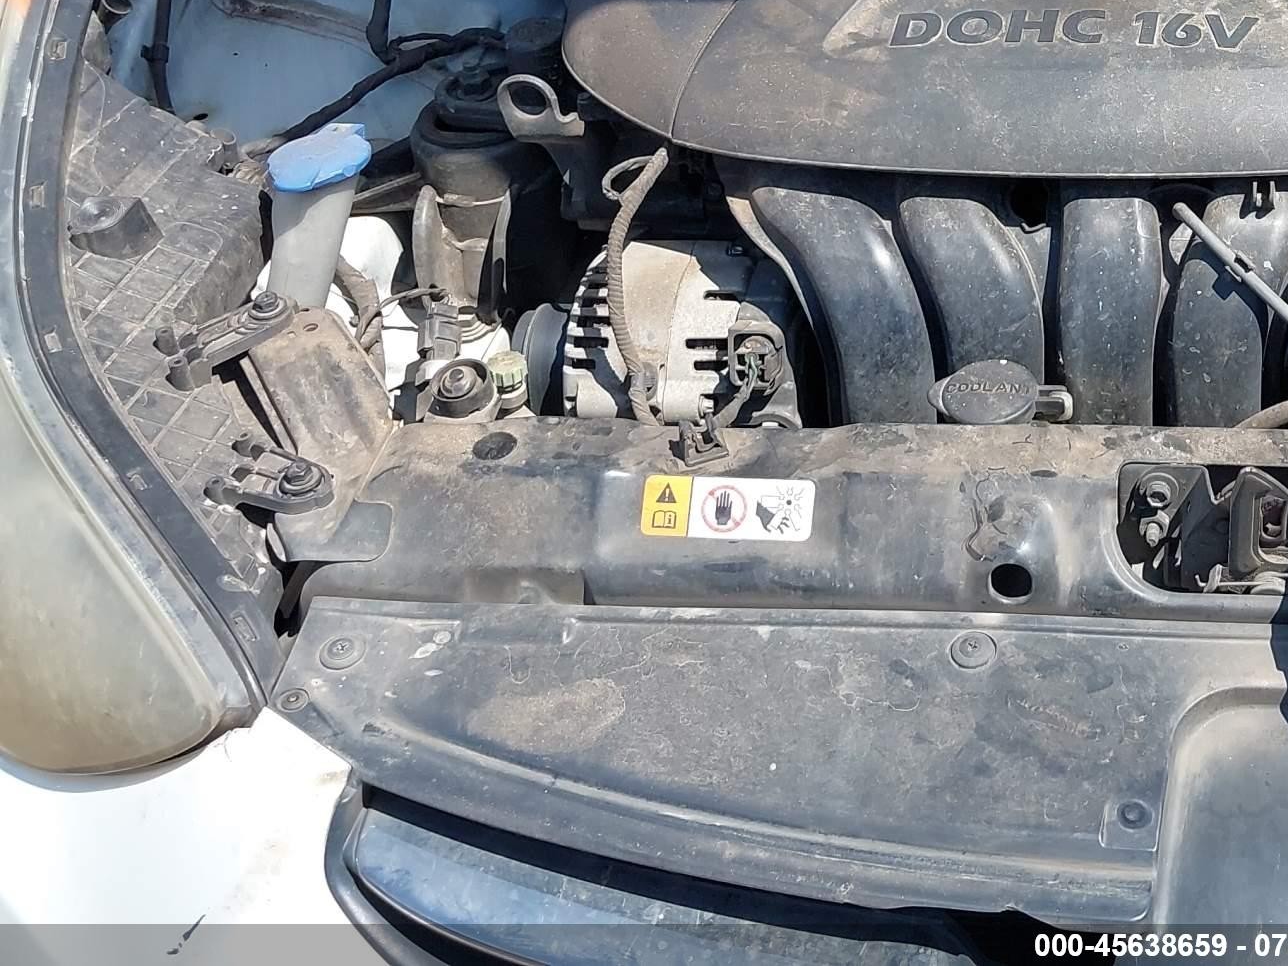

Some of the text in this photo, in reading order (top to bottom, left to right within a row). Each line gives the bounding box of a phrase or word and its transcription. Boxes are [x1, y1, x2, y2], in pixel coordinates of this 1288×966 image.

[888, 9, 1260, 52] DOHC 16V
[945, 381, 1031, 396] COOLANT
